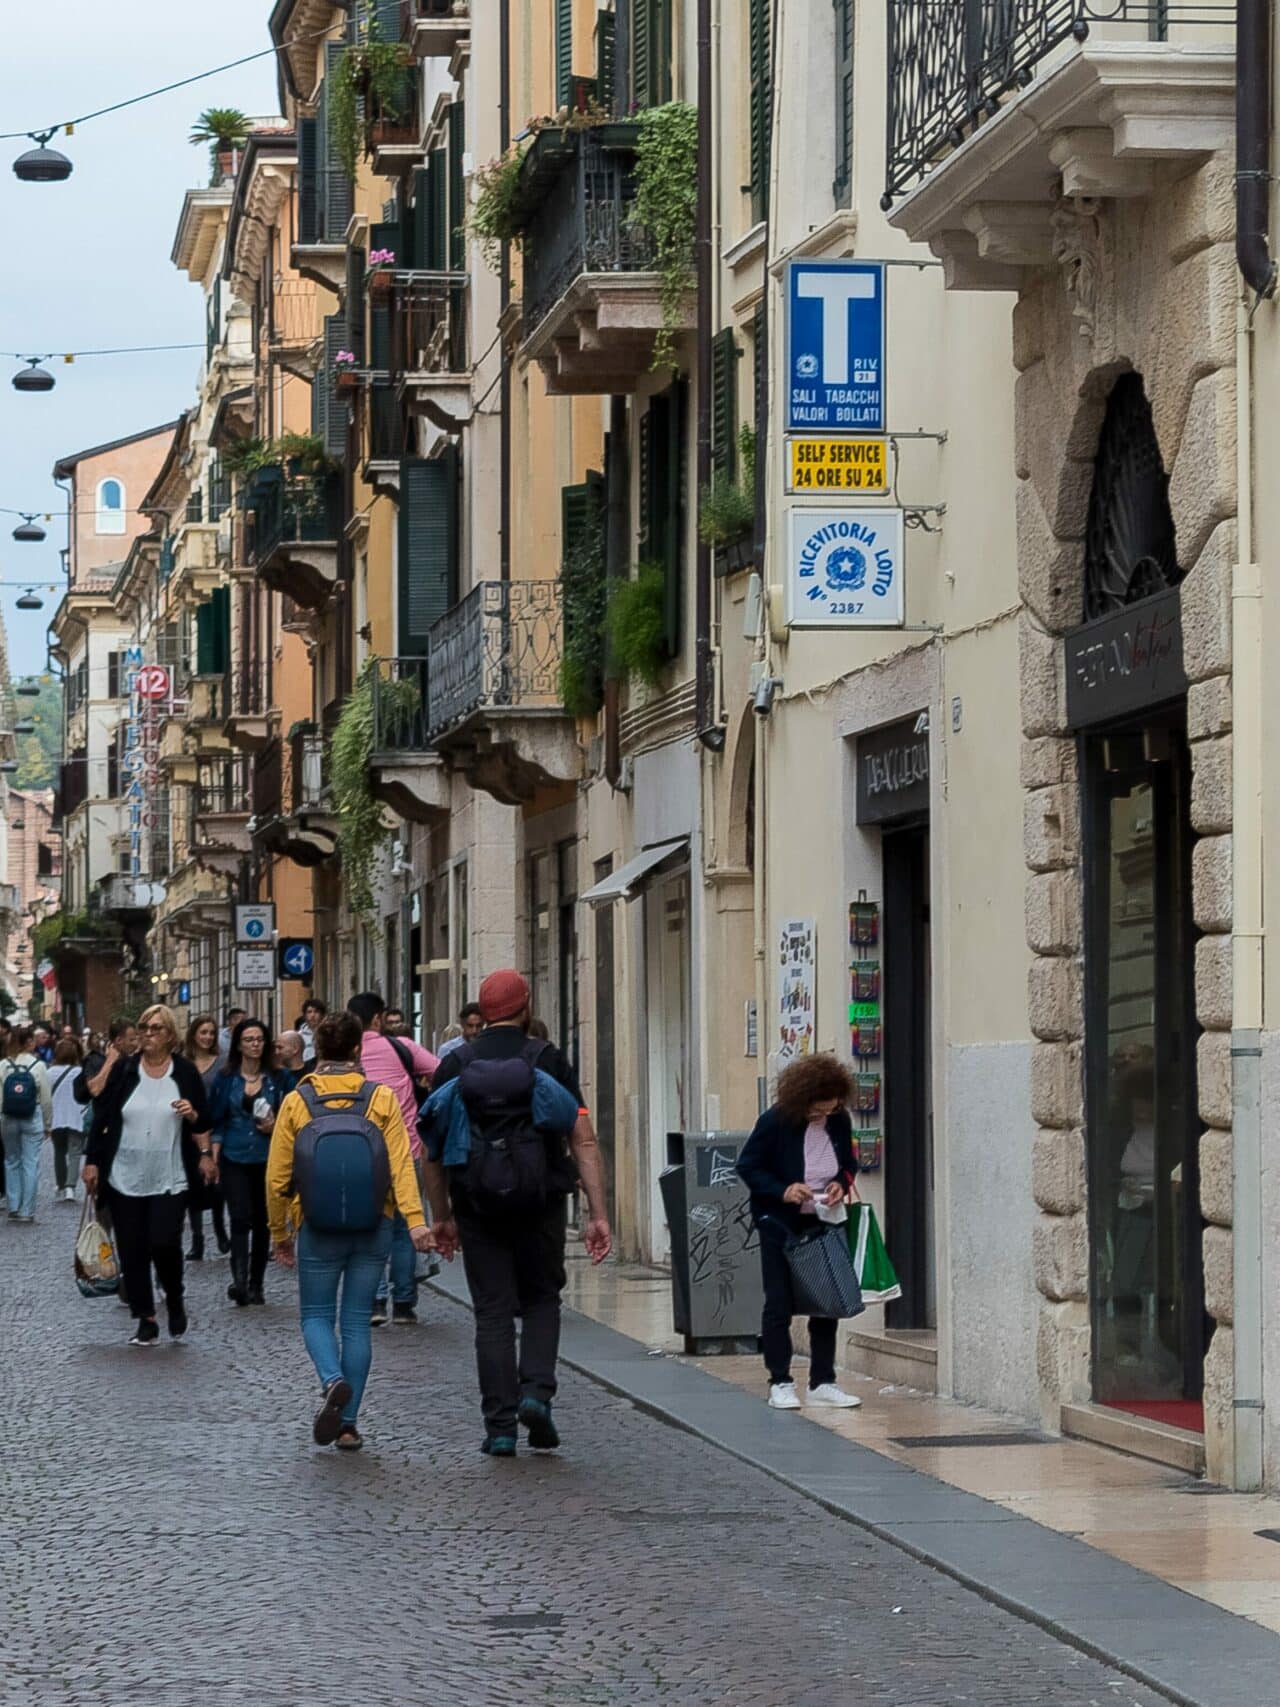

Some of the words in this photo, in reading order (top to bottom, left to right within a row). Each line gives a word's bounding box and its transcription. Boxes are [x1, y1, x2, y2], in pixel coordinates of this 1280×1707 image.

[798, 272, 875, 384] T
[792, 389, 816, 403] SALI
[825, 390, 879, 404] TABACCHI
[792, 407, 828, 421] VALORI
[836, 407, 879, 421] BOLLATI
[798, 445, 825, 463] SELF
[830, 445, 880, 463] SERVICE
[796, 468, 811, 486] 24
[816, 468, 841, 486] ORE
[846, 468, 861, 486] SU
[866, 468, 882, 486] 24
[799, 521, 876, 577] RICEVITORIA
[872, 548, 893, 597] LOTTO
[136, 671, 165, 692] 12
